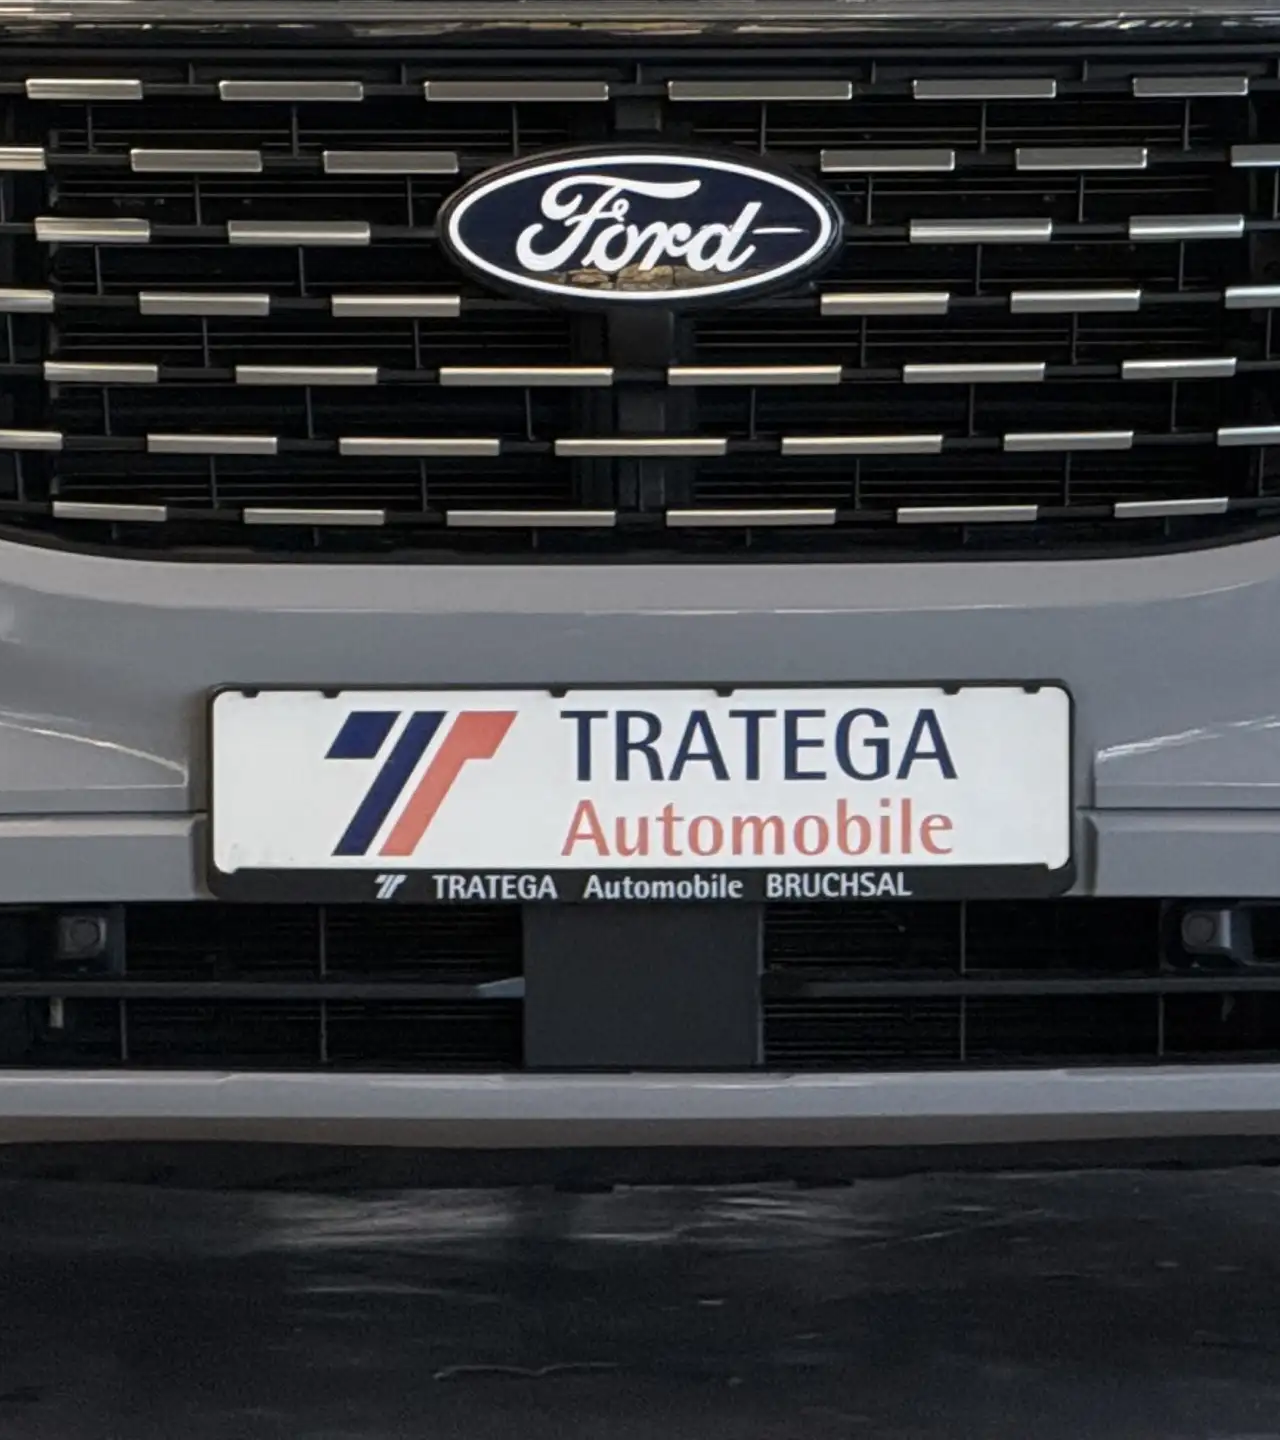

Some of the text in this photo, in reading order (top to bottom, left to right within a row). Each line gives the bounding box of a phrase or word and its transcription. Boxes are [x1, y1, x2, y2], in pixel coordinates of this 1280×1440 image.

[516, 175, 809, 271] Ford
[561, 708, 958, 782] TRATEGA
[562, 799, 952, 858] Automobile
[432, 871, 914, 901] TRATEGA Automobile BRUCHSAL
